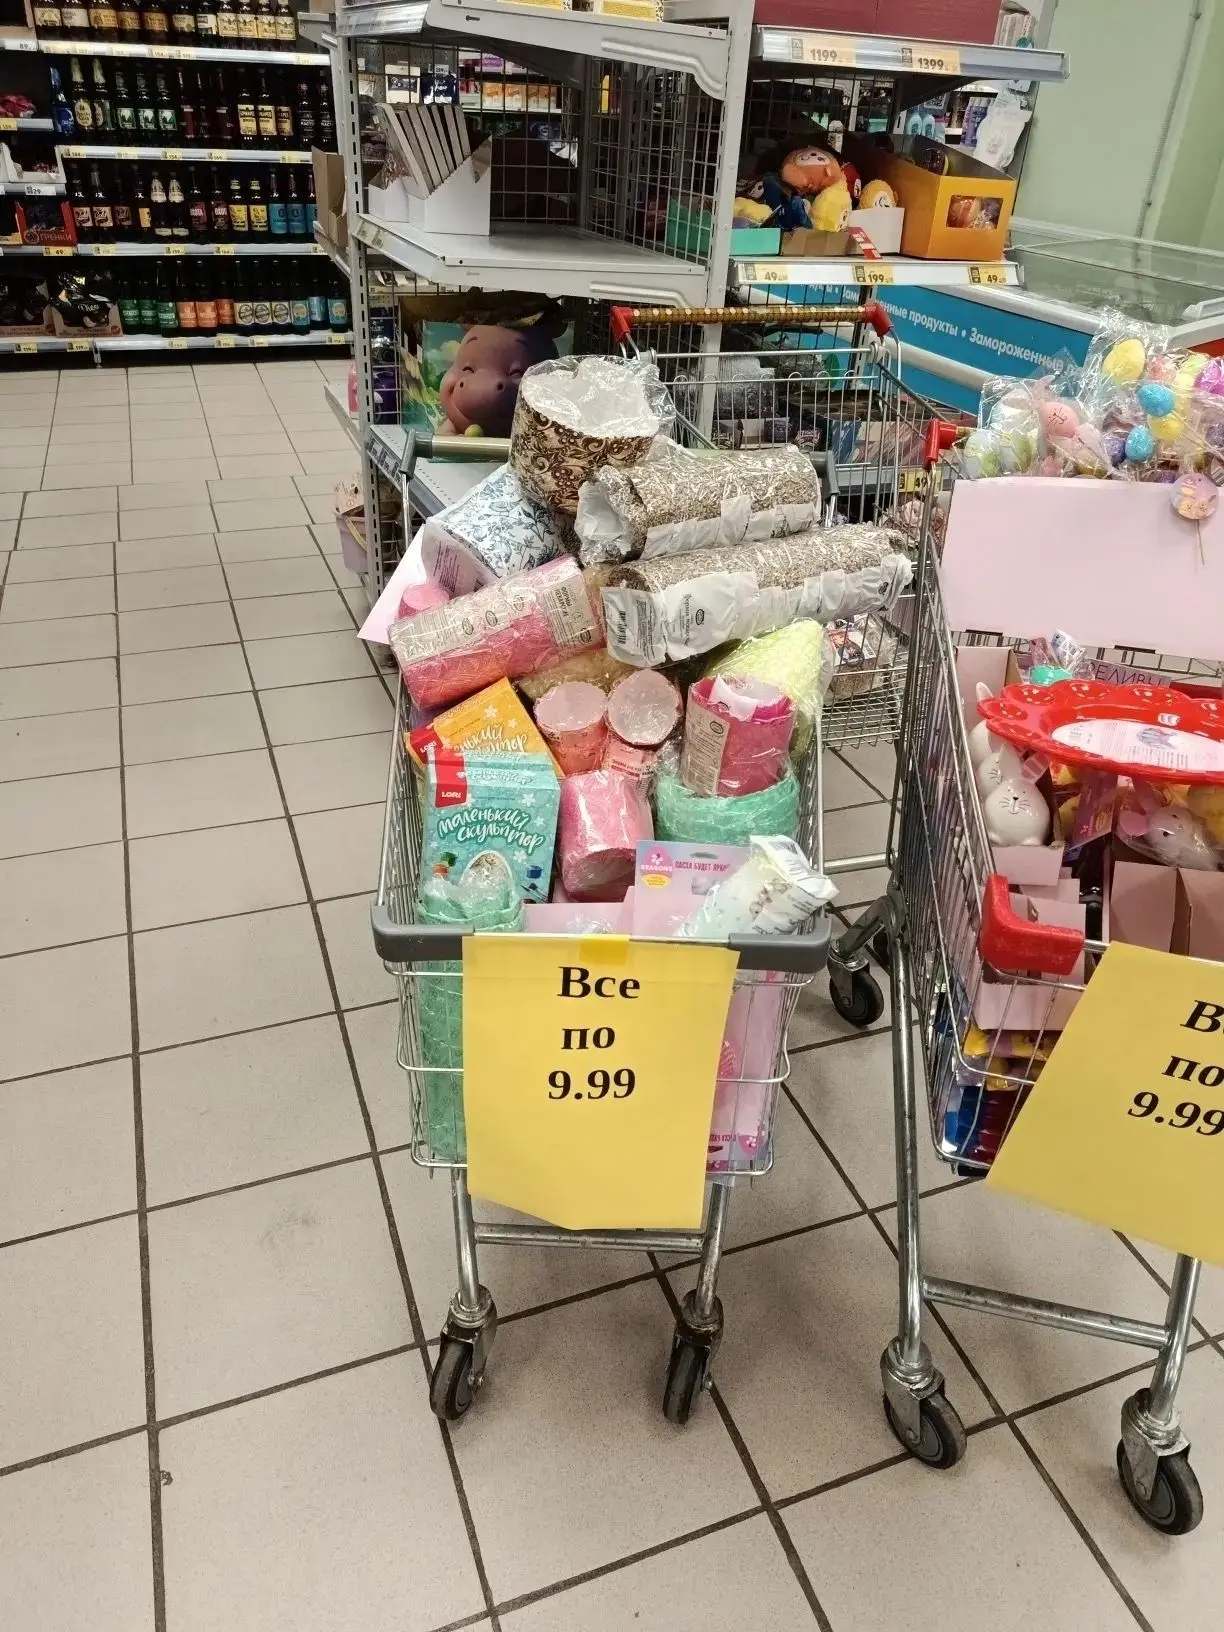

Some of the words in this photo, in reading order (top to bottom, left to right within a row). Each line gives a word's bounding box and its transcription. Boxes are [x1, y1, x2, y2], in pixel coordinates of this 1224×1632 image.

[809, 48, 838, 62] 1199
[917, 57, 945, 71] 1399
[40, 233, 72, 241] ГРЕНКИ
[764, 271, 778, 281] 49
[867, 274, 885, 283] 199
[986, 274, 998, 284] 49
[908, 311, 958, 337] продукты
[968, 327, 1065, 372] Замороженные
[915, 477, 928, 488] 49
[420, 740, 438, 753] LORI
[441, 791, 462, 799] LORI
[694, 862, 711, 872] БУДЕТ
[556, 965, 641, 999] Все
[1179, 999, 1224, 1035] В
[560, 1026, 616, 1050] по
[1161, 1055, 1224, 1087] по
[547, 1068, 636, 1100] 9.99
[1127, 1091, 1224, 1136] 9.99
